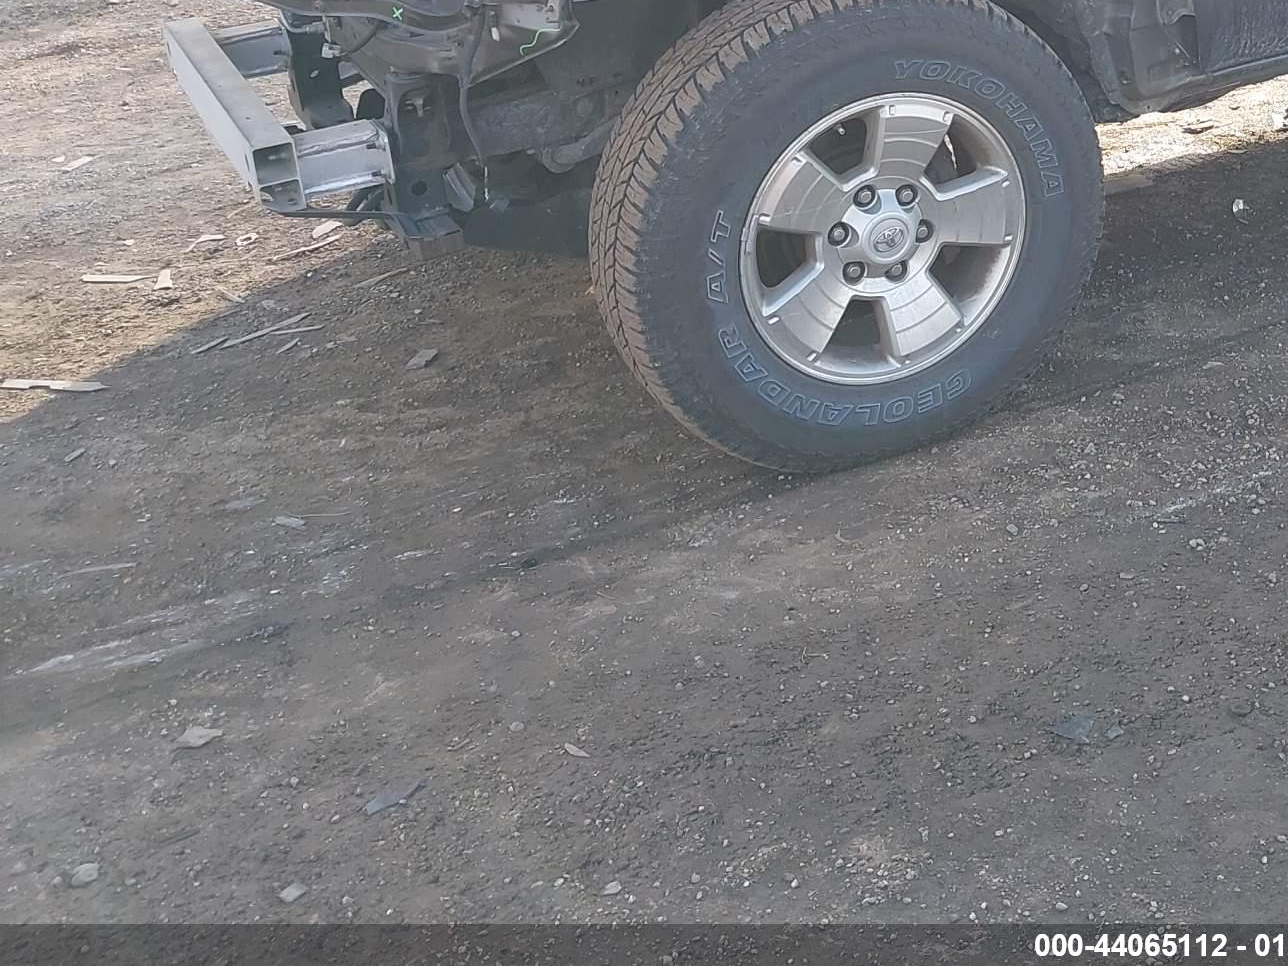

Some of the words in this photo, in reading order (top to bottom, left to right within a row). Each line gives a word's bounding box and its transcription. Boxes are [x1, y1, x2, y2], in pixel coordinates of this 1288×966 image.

[894, 59, 1065, 198] YOKOHAMA
[706, 209, 732, 304] A/T
[717, 324, 973, 426] GEOLANDAR
